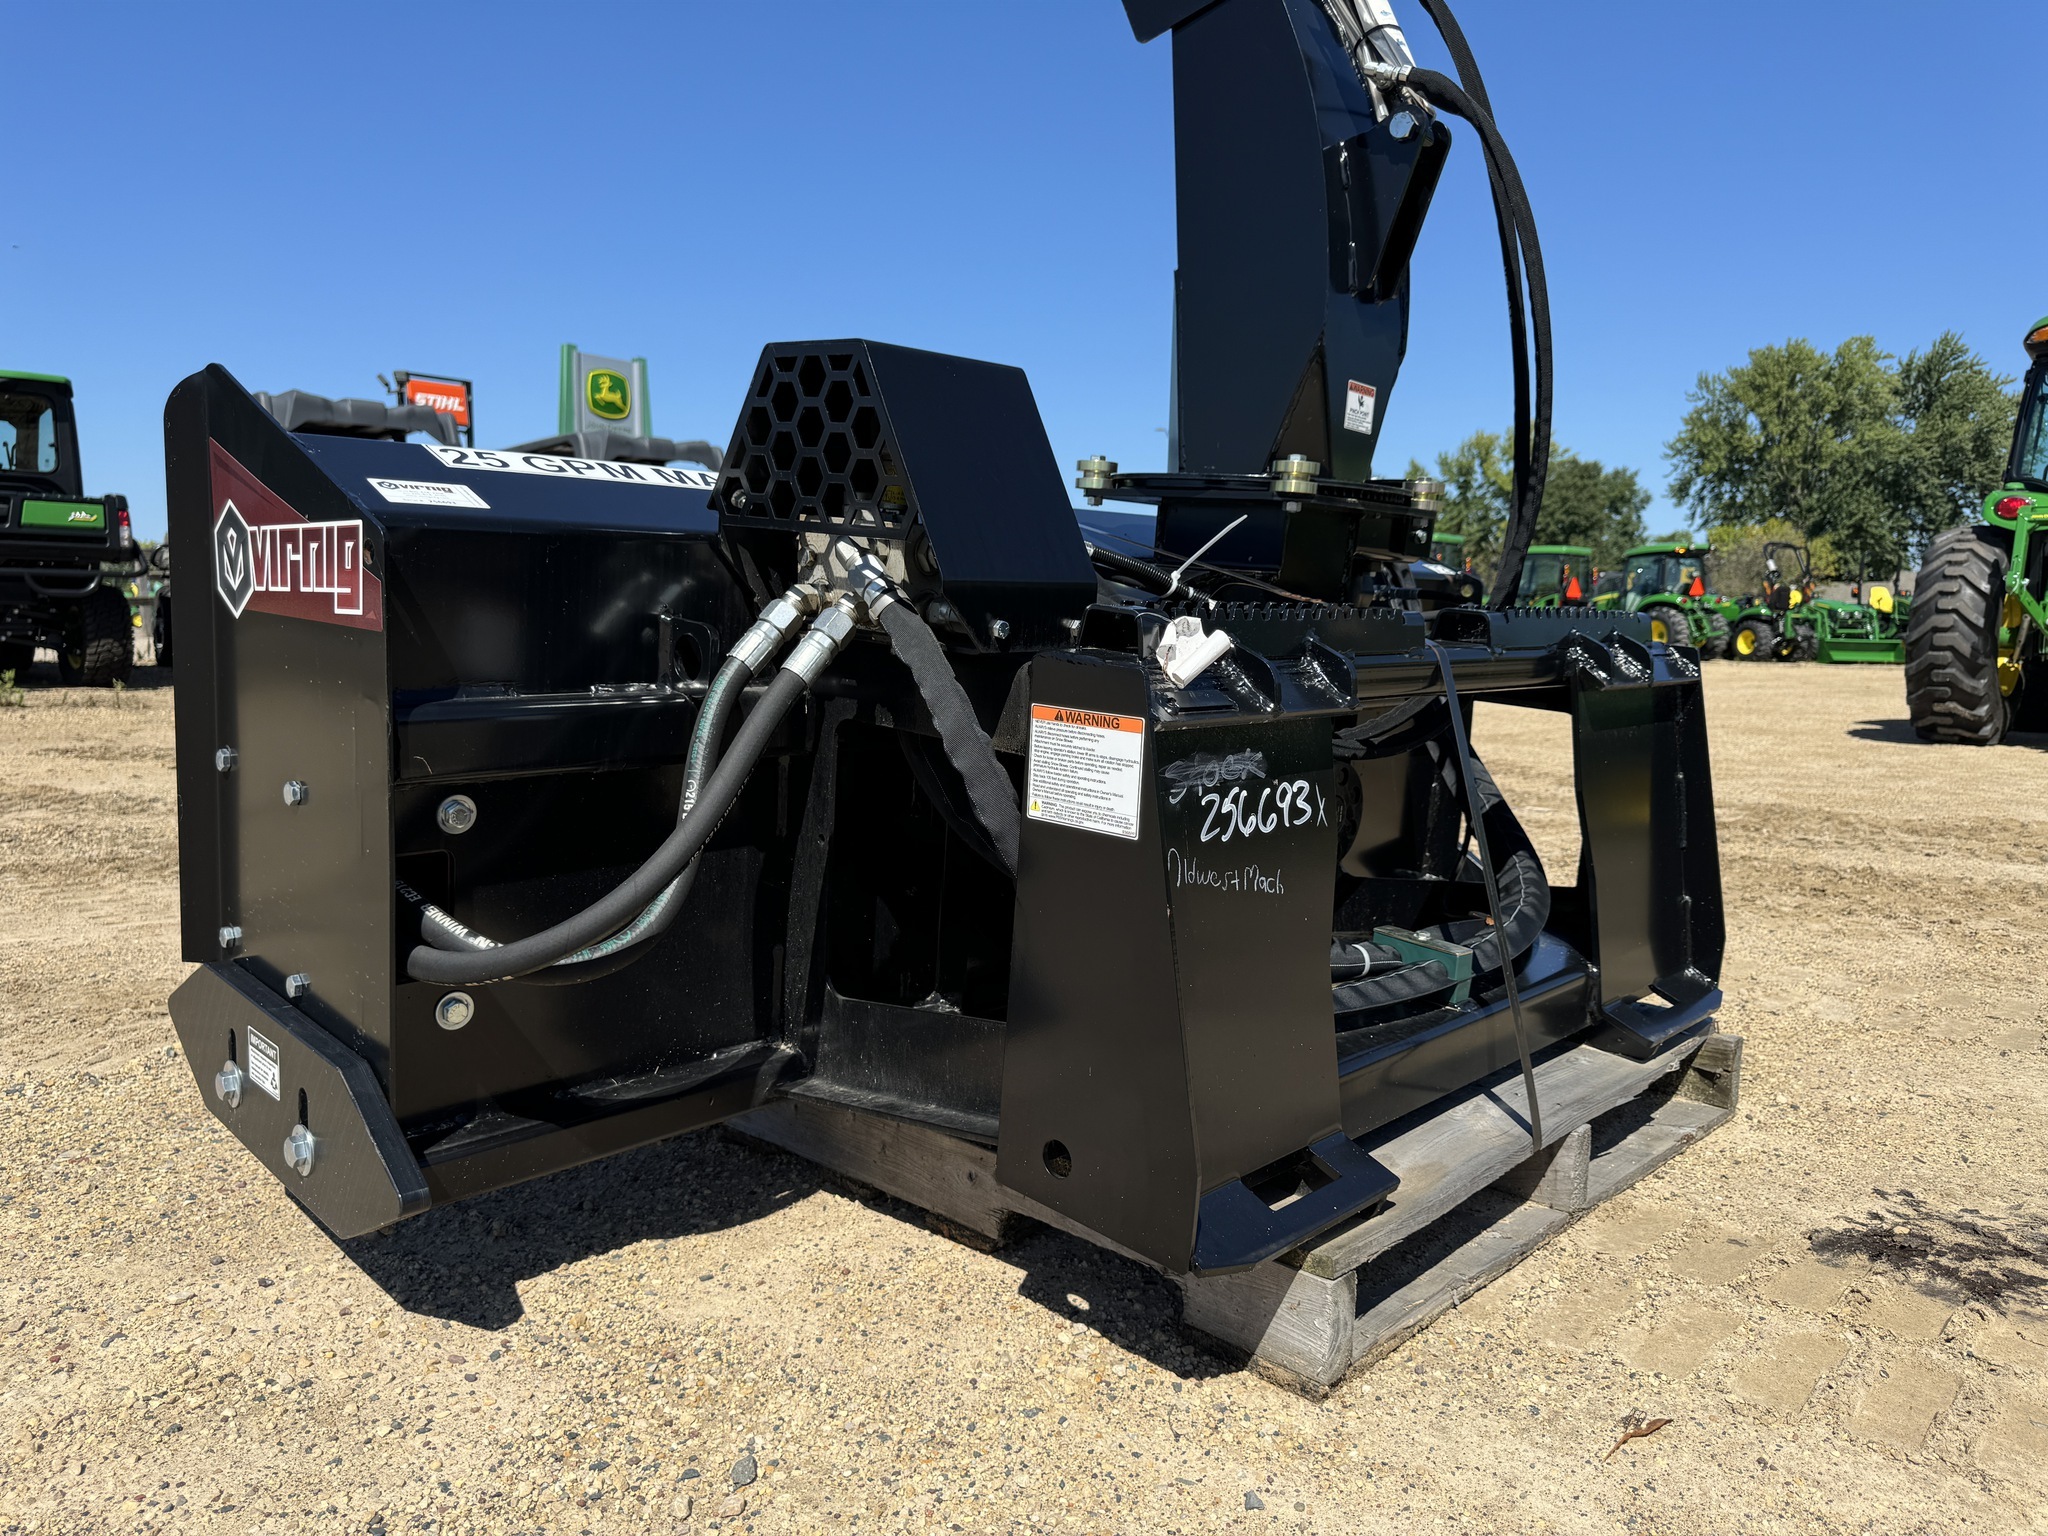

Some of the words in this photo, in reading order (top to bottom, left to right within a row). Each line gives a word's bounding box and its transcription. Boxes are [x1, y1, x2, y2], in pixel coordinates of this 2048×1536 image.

[415, 392, 465, 412] STIHL
[439, 448, 511, 468] 25
[522, 455, 648, 481] GPM
[1065, 711, 1120, 729] WARNING
[1200, 780, 1312, 842] 256693
[1244, 864, 1284, 894] Mach
[421, 903, 469, 938] WINNER
[250, 1033, 277, 1060] IMPORTANT
